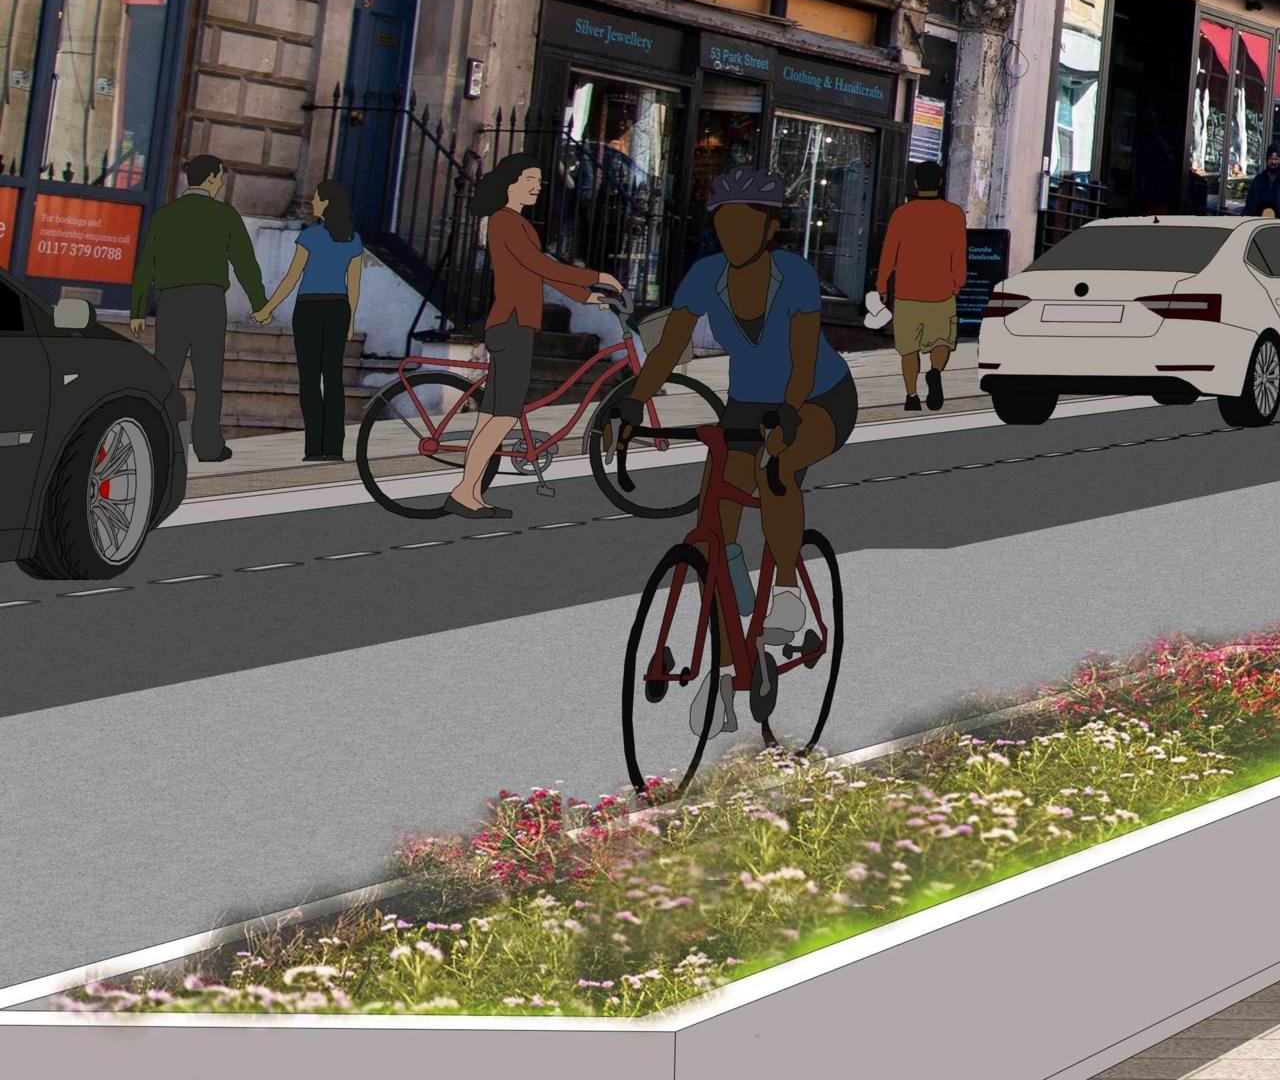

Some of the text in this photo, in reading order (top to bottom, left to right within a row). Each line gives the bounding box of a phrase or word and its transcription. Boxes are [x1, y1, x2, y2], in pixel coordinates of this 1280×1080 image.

[575, 18, 653, 52] Silver Jewellery
[709, 47, 721, 62] 53
[722, 50, 743, 65] Park
[744, 54, 769, 70] Street
[783, 66, 884, 100] Clothing & Handicrafts
[38, 240, 122, 260] 0117 379 0788
